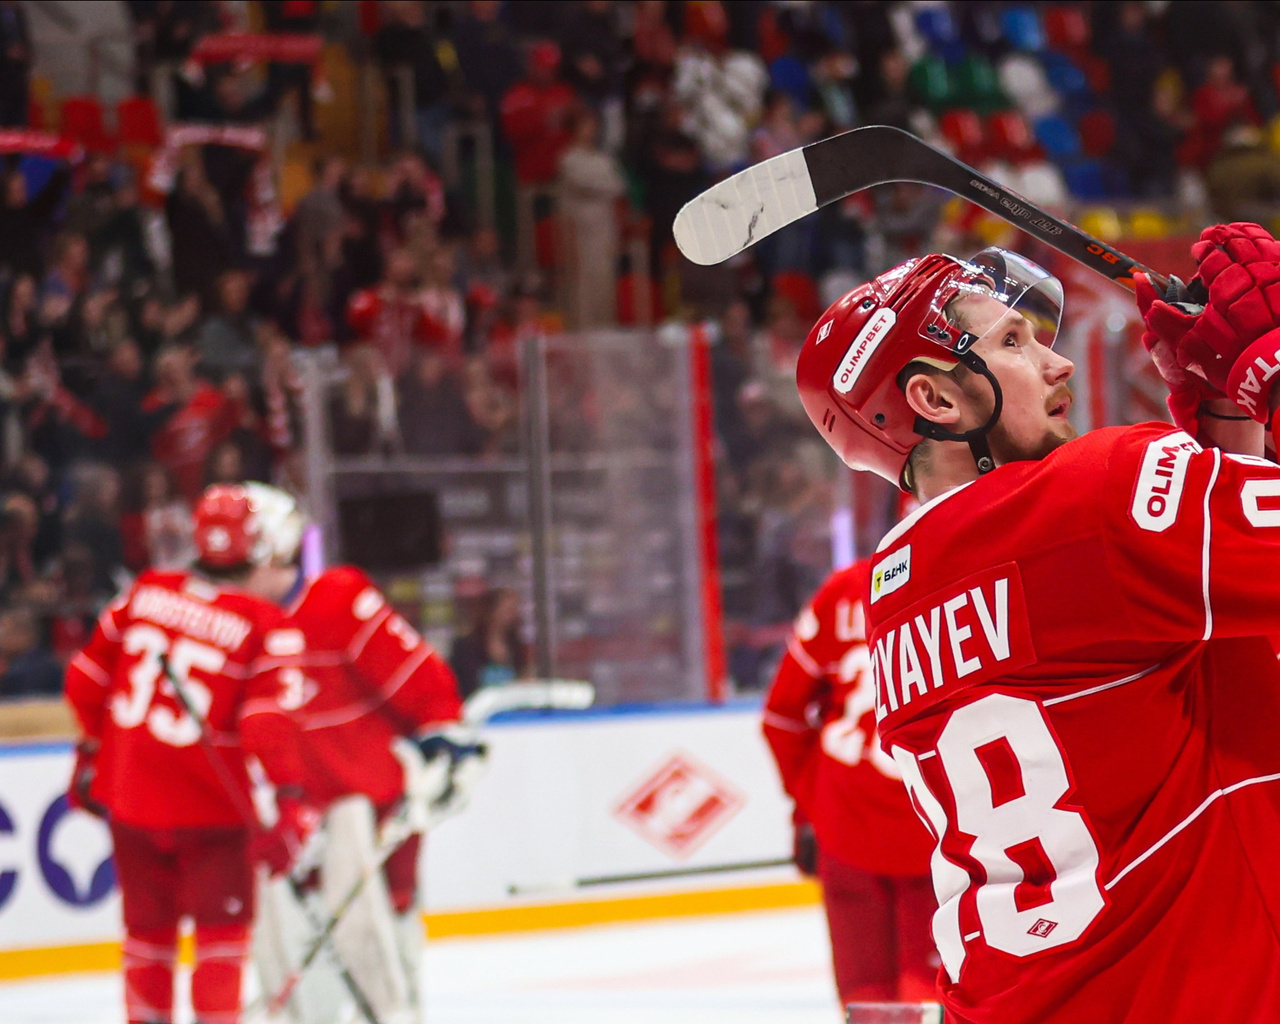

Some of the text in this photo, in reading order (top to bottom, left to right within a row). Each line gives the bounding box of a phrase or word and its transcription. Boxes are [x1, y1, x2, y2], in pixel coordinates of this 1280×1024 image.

[840, 314, 888, 385] OLIMPBET
[884, 559, 908, 583] БАНК
[110, 623, 227, 748] 35
